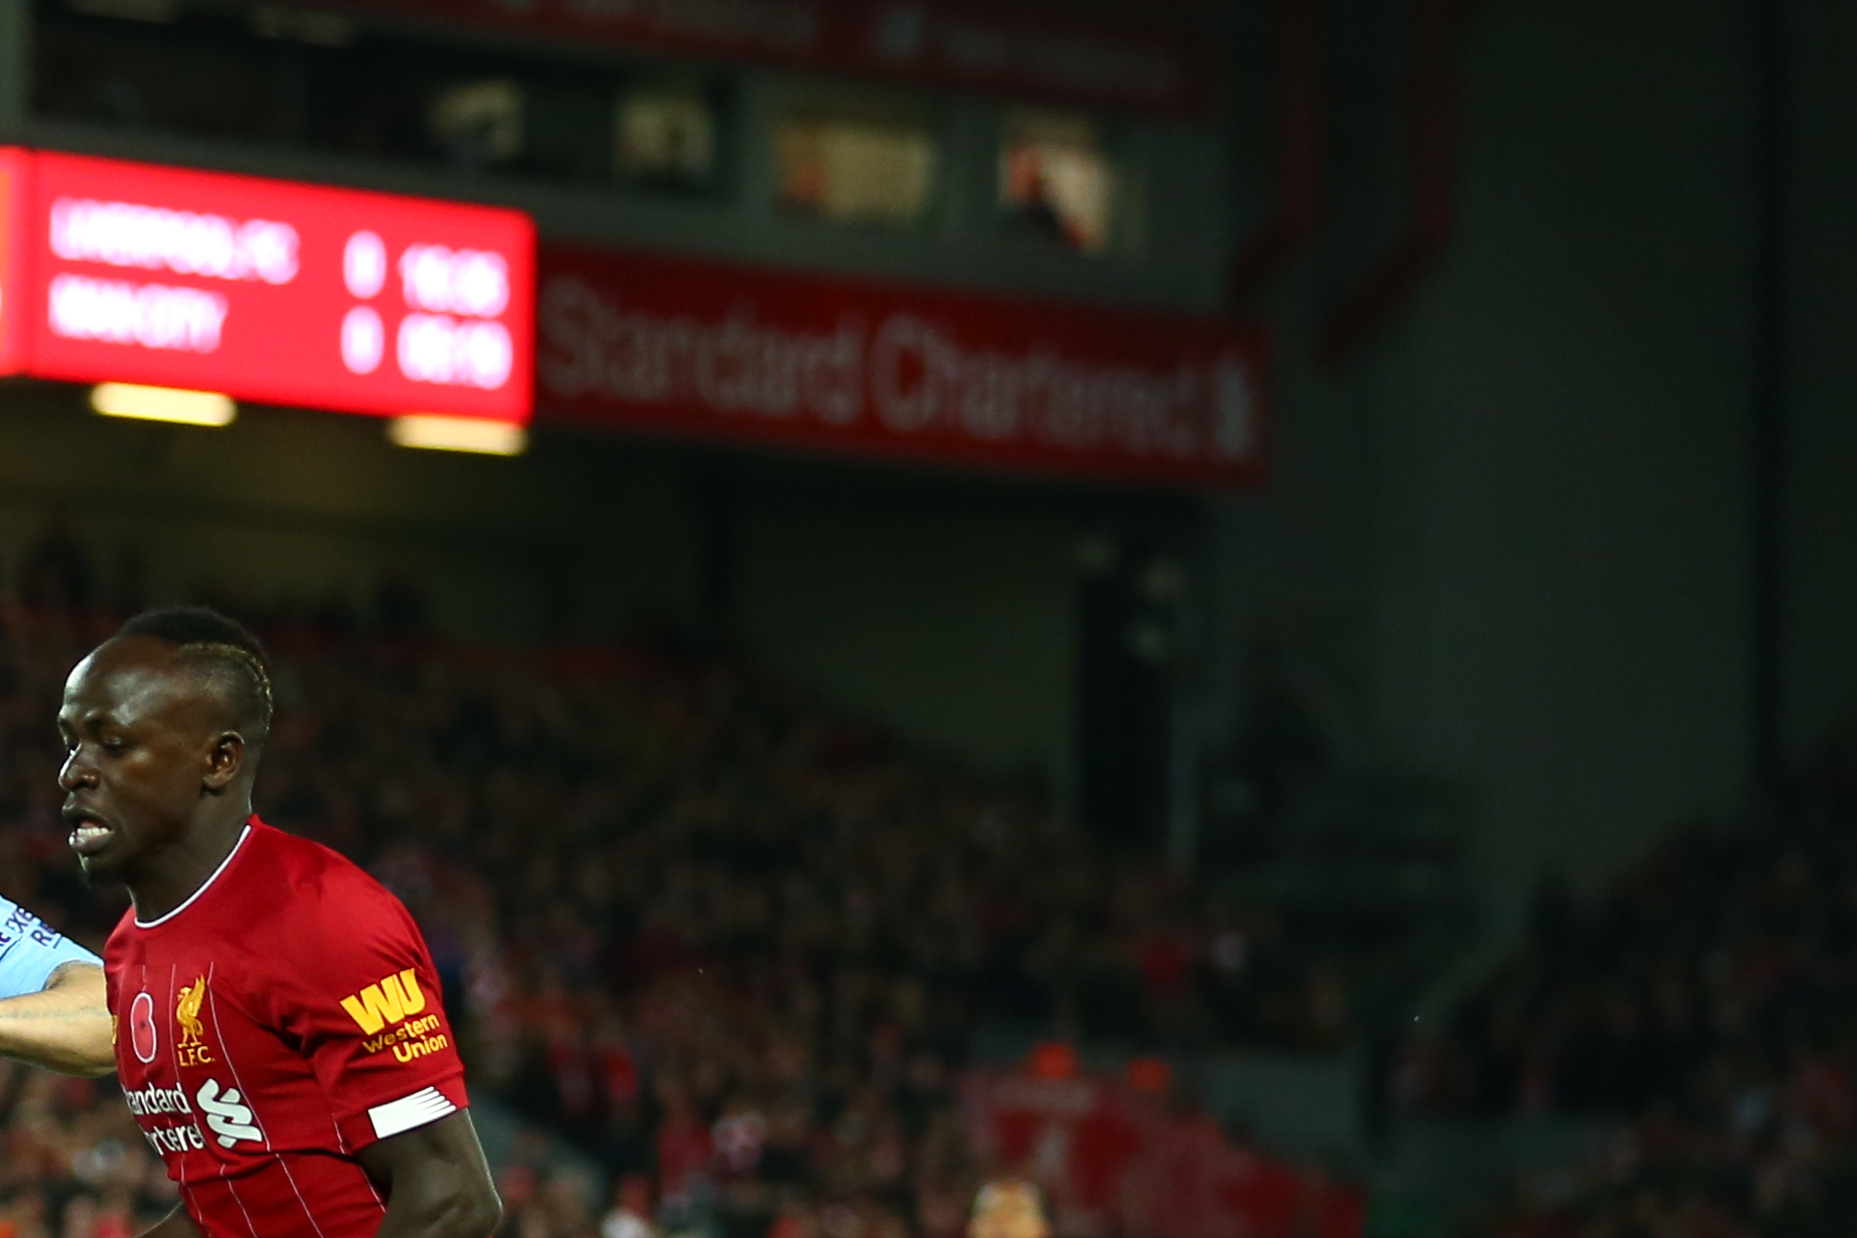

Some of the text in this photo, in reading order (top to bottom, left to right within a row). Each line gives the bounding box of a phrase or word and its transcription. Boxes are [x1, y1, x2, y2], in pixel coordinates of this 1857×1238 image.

[537, 276, 866, 426] Standard
[871, 315, 1198, 458] Chartered
[340, 967, 425, 1035] WU
[362, 1014, 440, 1053] Western
[392, 1034, 448, 1063] Union
